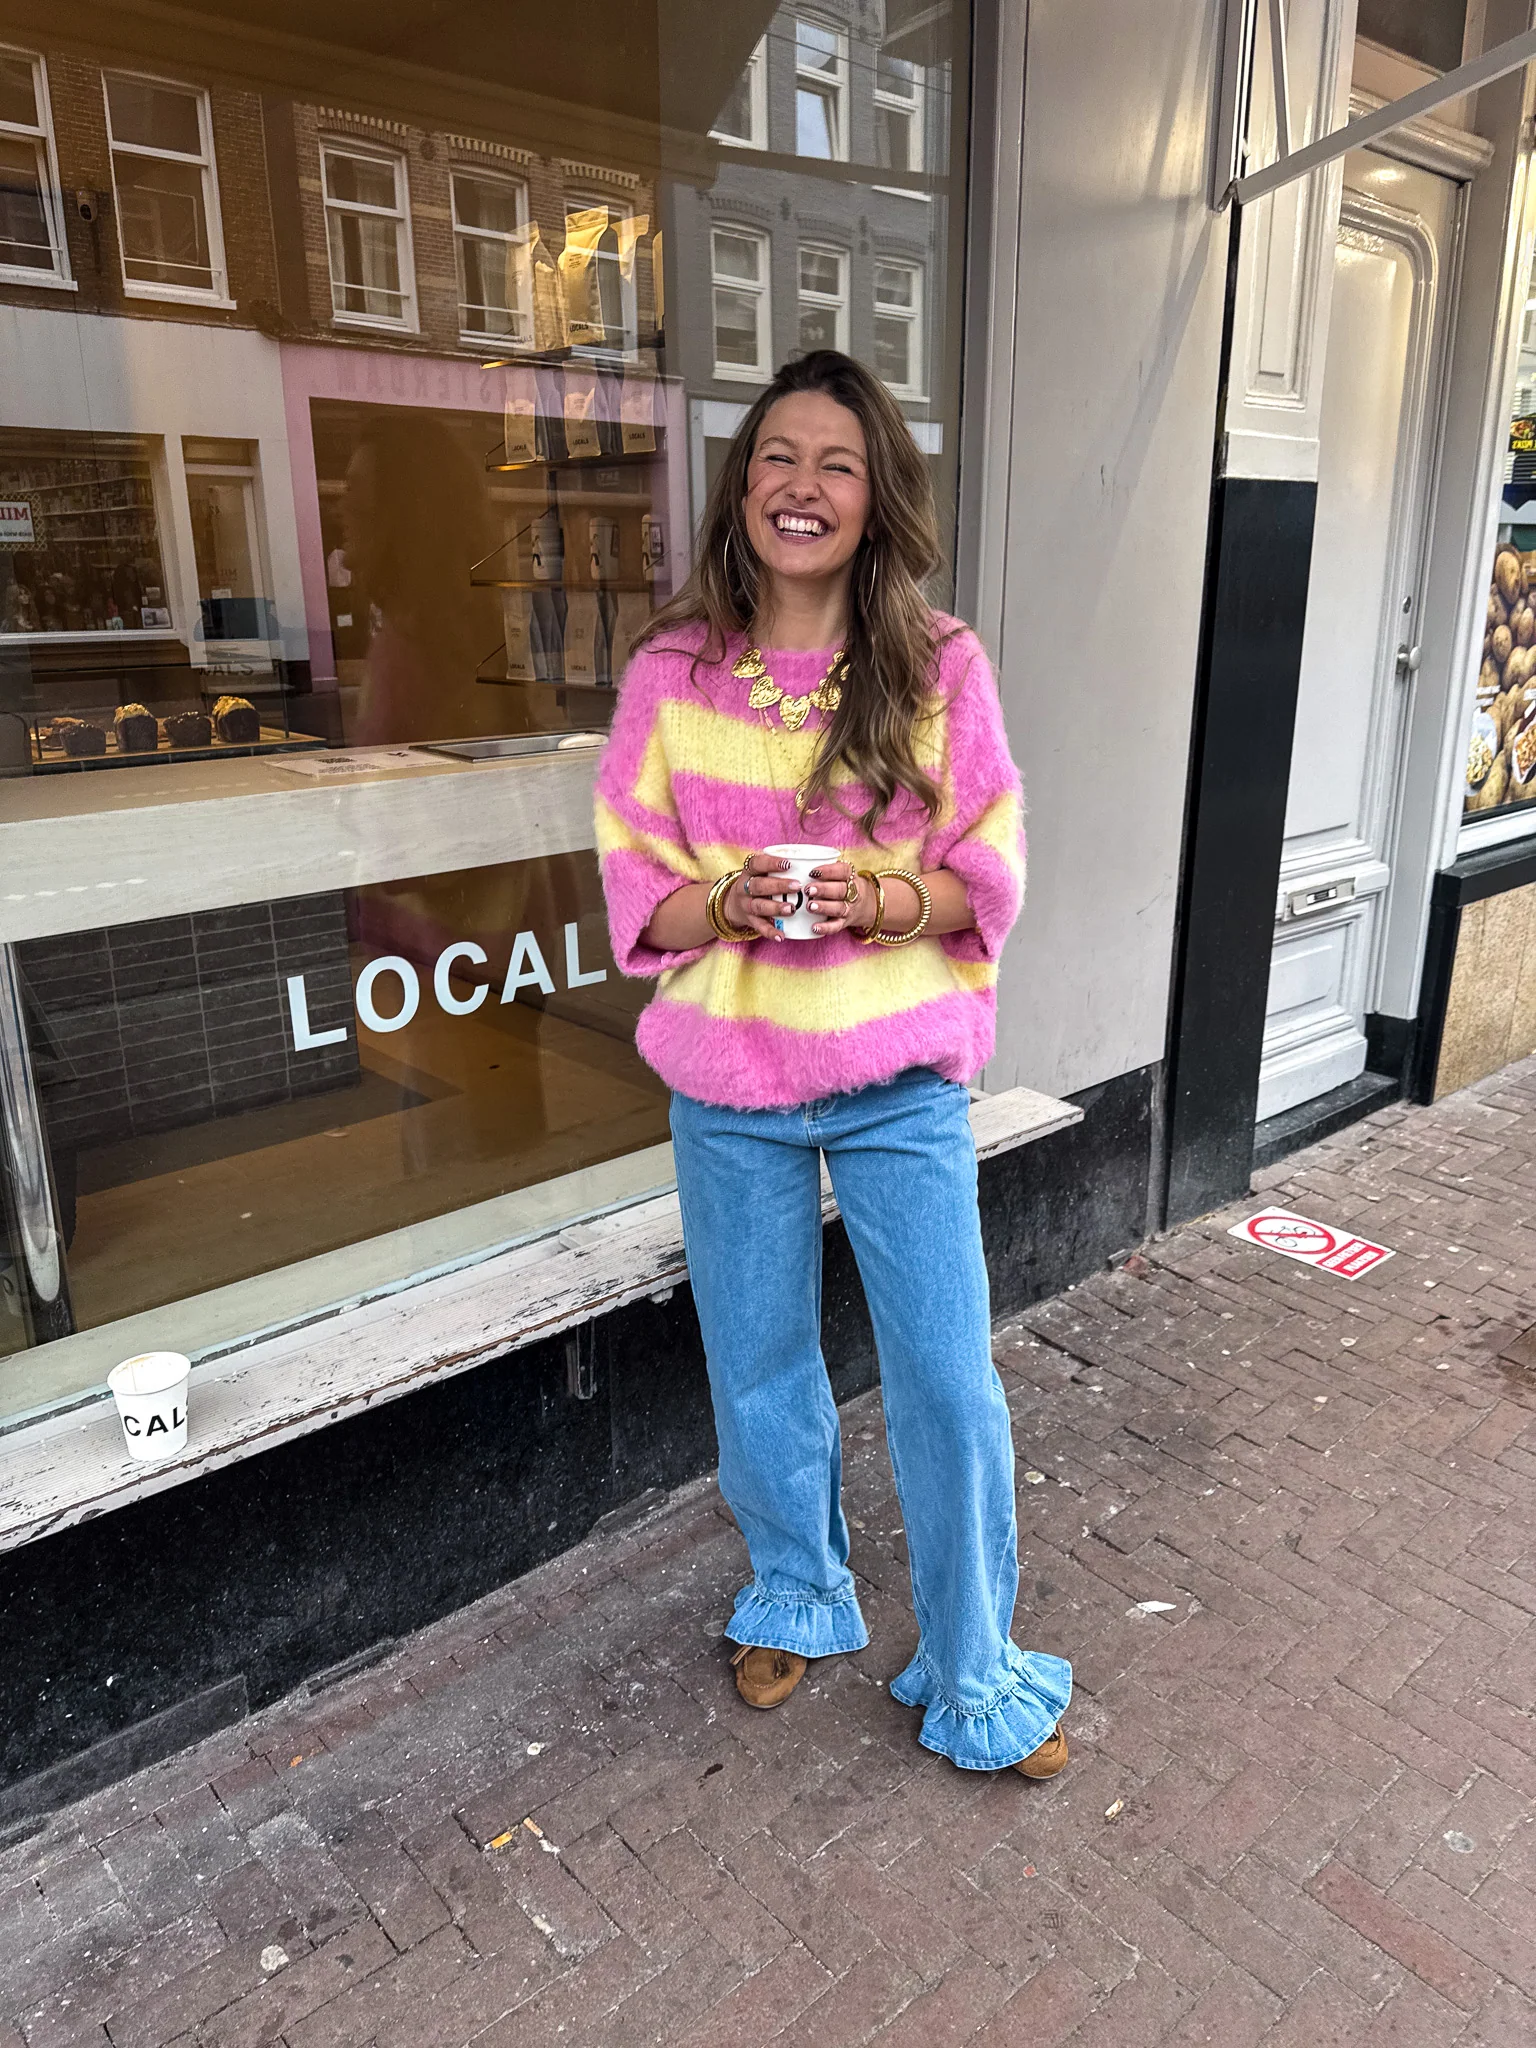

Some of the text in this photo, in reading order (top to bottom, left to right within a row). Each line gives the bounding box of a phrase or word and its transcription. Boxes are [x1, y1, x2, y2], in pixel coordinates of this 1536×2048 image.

[628, 432, 646, 440] LOCALS
[287, 922, 607, 1052] LOCAL
[124, 1405, 187, 1437] CAL
